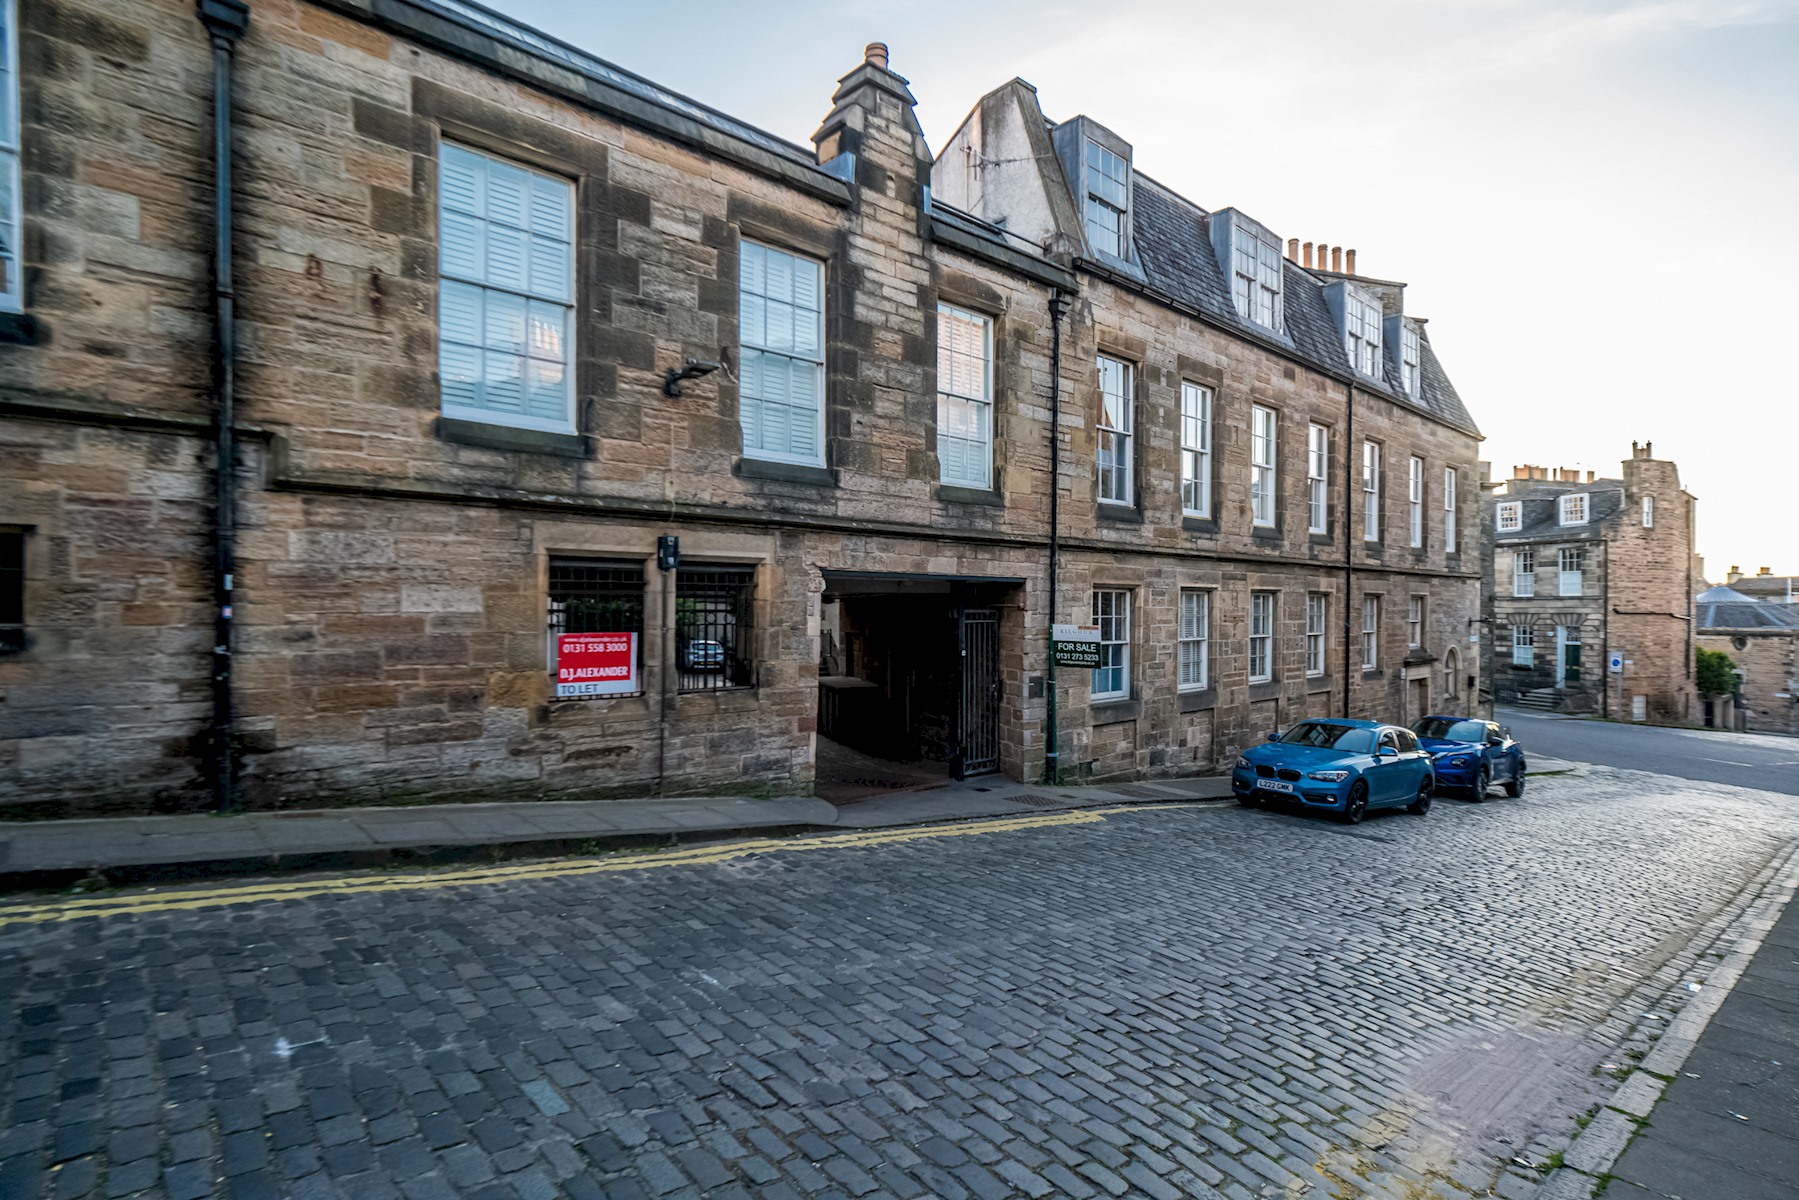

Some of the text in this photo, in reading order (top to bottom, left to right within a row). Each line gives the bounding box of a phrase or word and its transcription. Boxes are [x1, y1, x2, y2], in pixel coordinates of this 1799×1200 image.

[563, 643, 628, 653] 0131 558 3000
[1058, 643, 1097, 653] FOR SALE
[1056, 652, 1099, 662] 0131 273 5233
[561, 684, 598, 695] TO LET
[1259, 780, 1276, 789] L222
